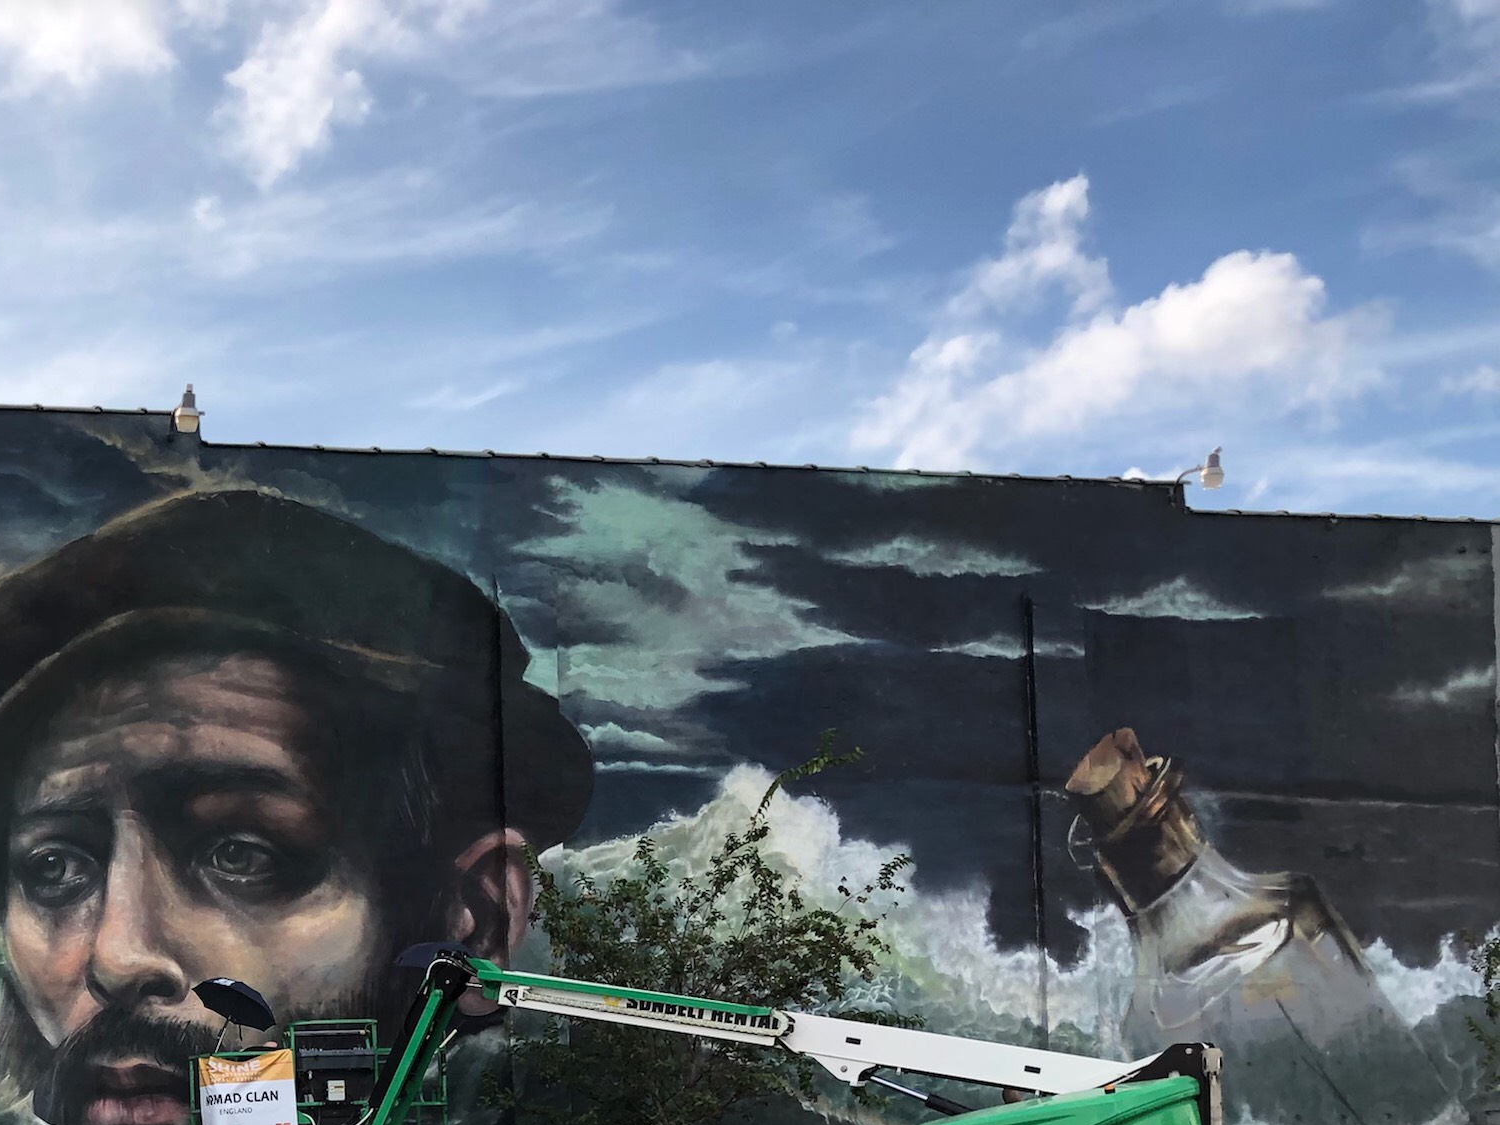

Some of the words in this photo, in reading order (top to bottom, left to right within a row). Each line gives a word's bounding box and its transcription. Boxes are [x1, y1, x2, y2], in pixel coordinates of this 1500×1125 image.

[626, 998, 704, 1019] SUNBELT
[208, 1060, 260, 1073] SHINE
[246, 1090, 279, 1102] CLAN
[219, 1107, 253, 1115] ENGLAND
